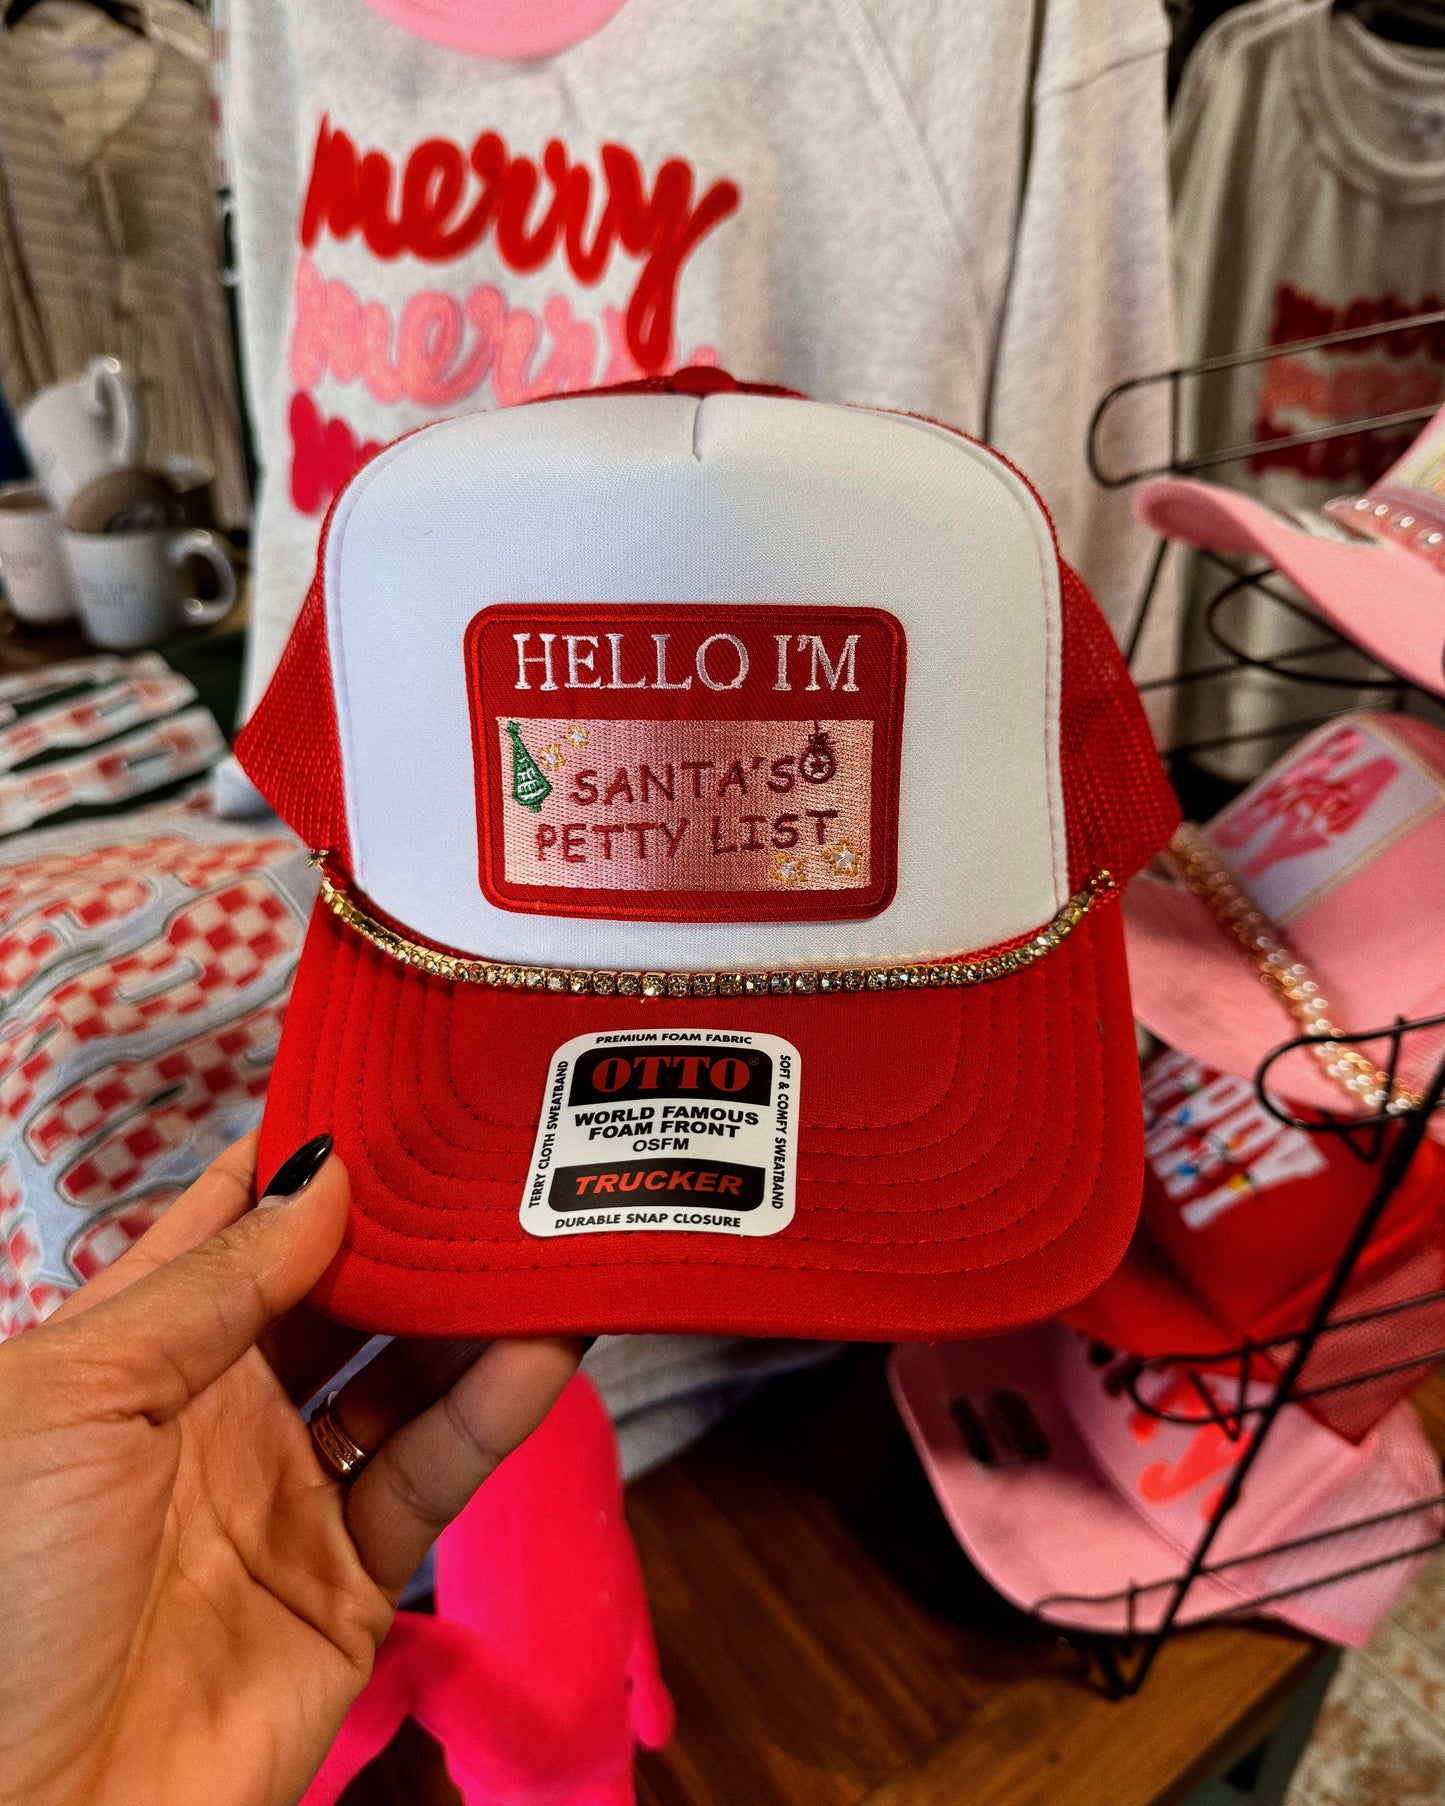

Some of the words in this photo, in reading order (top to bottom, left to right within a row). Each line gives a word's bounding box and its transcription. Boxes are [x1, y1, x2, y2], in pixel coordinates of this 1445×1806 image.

[300, 110, 739, 373] merry
[289, 254, 719, 410] merr
[512, 632, 751, 692] HELLO
[771, 633, 862, 693] I'M
[569, 753, 797, 807] SANTA'S
[534, 818, 691, 863] PETTY
[711, 809, 839, 855] LIST
[595, 1033, 658, 1044] PREMIUM
[661, 1032, 702, 1042] FOAM
[705, 1033, 753, 1045] FABRIC
[591, 1056, 750, 1093] OTTO
[778, 1081, 790, 1090] &
[779, 1054, 792, 1080] SOFT
[546, 1060, 569, 1130] SWEATBAND
[574, 1106, 656, 1128] WORLD
[662, 1105, 760, 1126] FAMOUS
[588, 1122, 653, 1141] FOAM
[660, 1120, 741, 1138] FRONT
[775, 1093, 789, 1135] COMFY
[538, 1132, 557, 1170] CLOTH
[632, 1137, 690, 1152] OSFM
[528, 1173, 547, 1209] TERRY
[574, 1169, 744, 1197] TRUCKER
[771, 1137, 787, 1210] SWEATBAND
[554, 1213, 622, 1229] DURABLE
[625, 1212, 669, 1225] SNAP
[673, 1212, 742, 1228] CLOSURE
